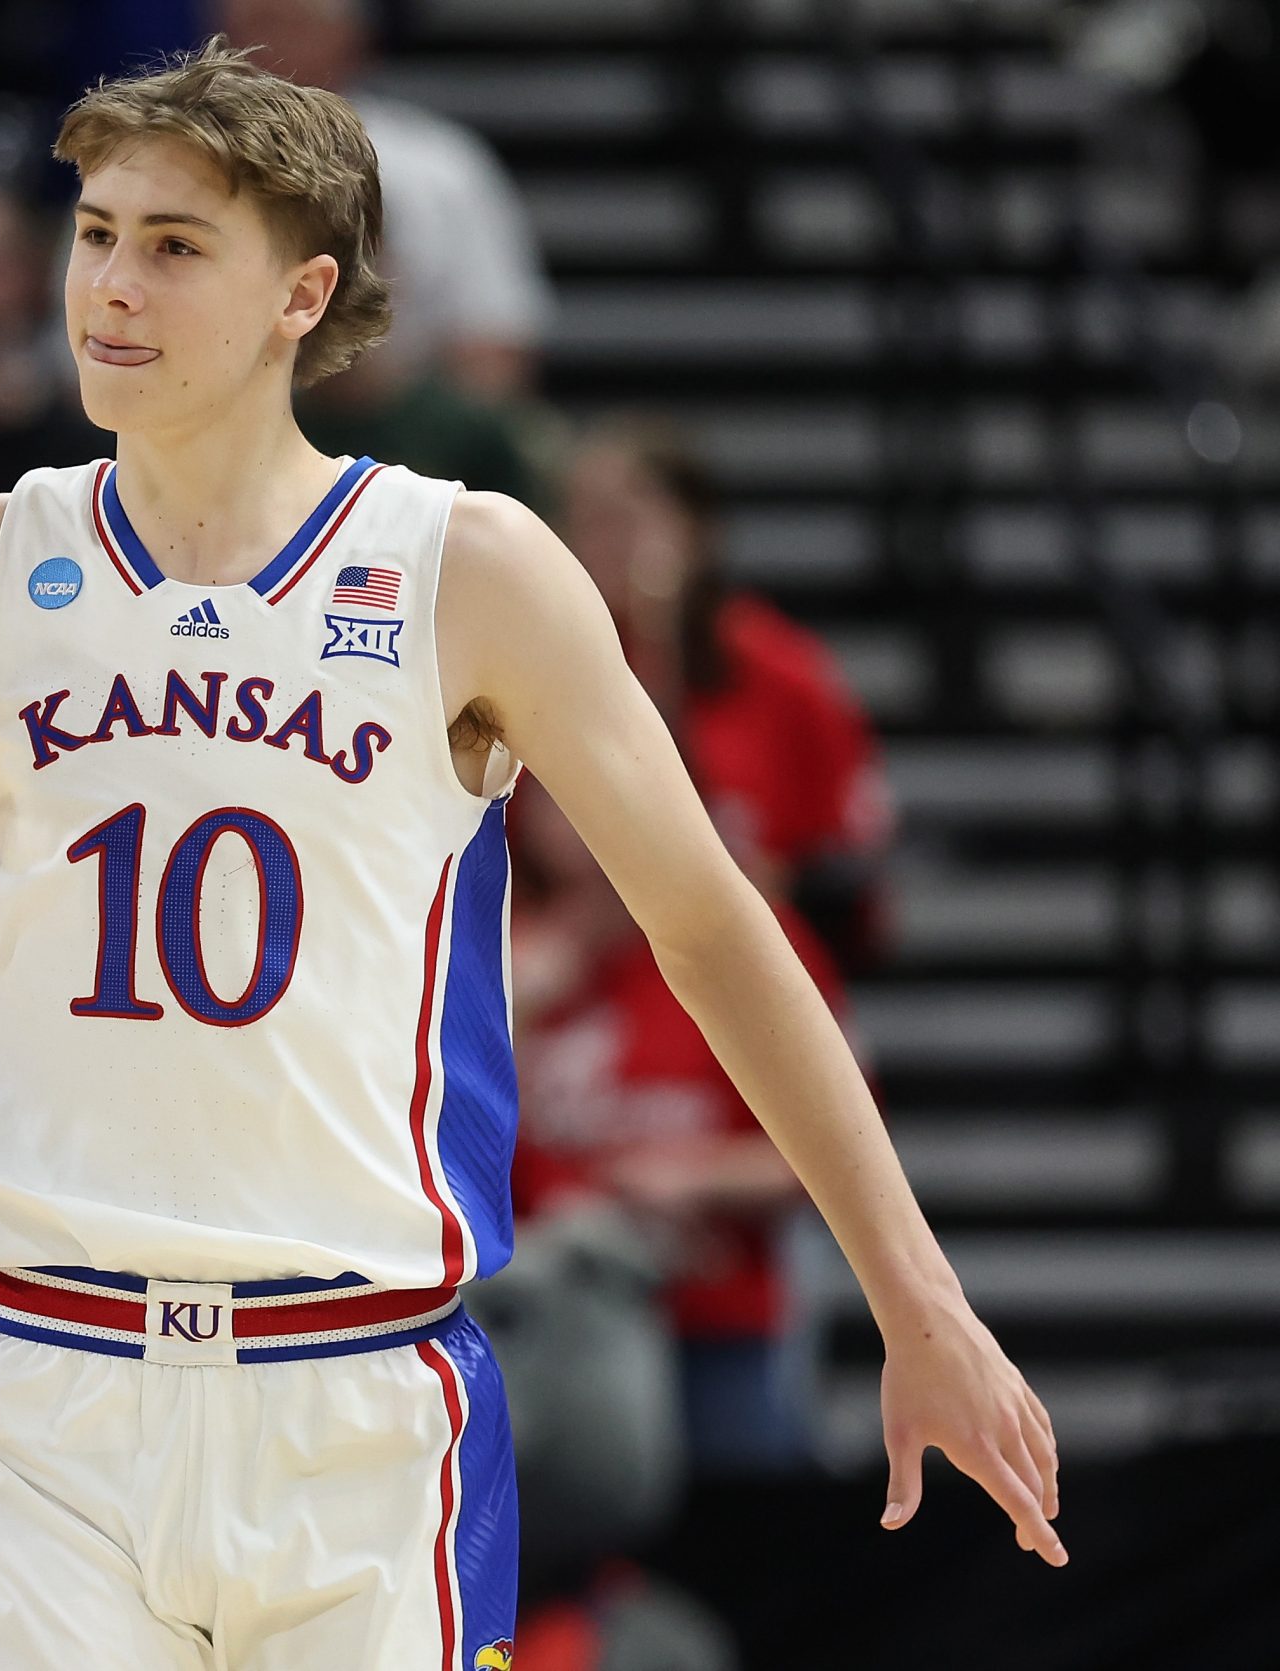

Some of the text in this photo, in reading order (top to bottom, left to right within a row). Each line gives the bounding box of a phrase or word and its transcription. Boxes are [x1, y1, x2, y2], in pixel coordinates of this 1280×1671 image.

[34, 581, 78, 597] NCAA
[170, 621, 230, 640] adidas
[322, 614, 404, 668] XII
[19, 669, 392, 784] KANSAS
[66, 802, 304, 1027] 10
[158, 1301, 224, 1342] KU
